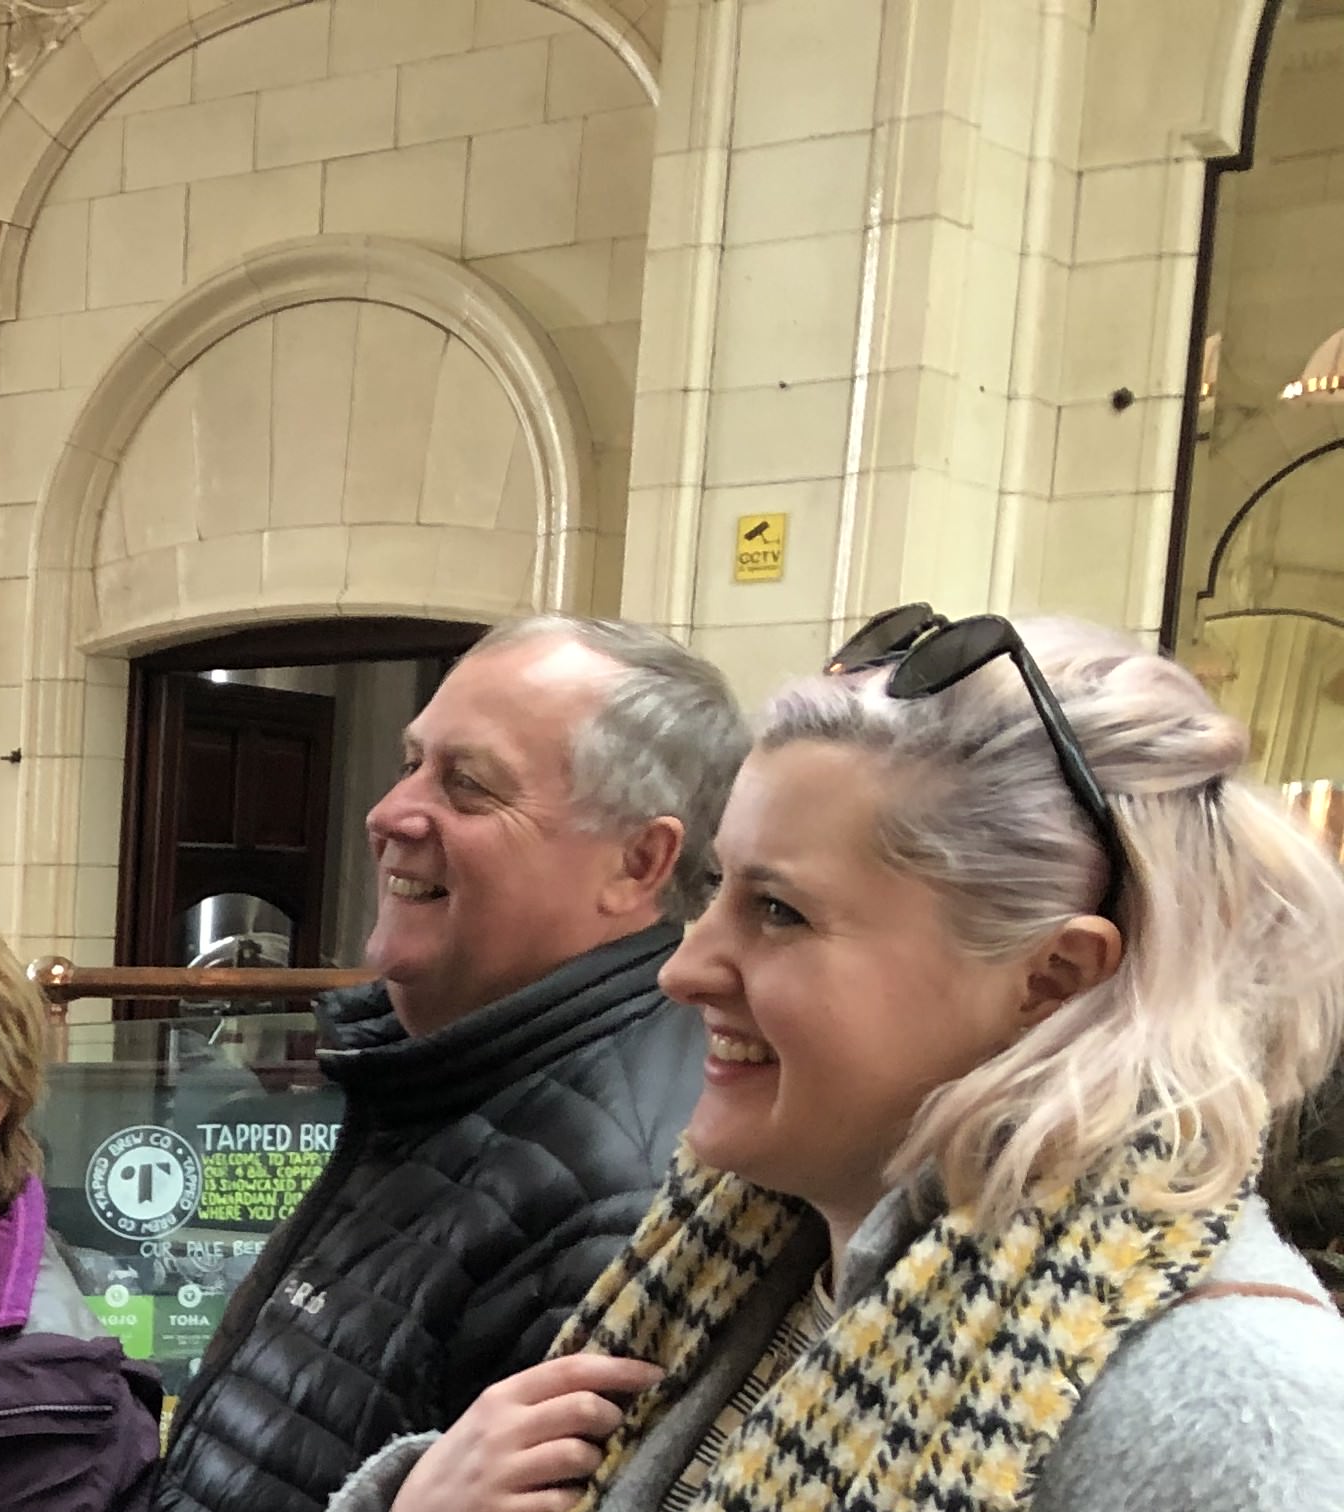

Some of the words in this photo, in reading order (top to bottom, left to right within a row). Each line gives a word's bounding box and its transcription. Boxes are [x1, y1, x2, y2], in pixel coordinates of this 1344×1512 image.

[739, 550, 781, 565] CCTV
[108, 1132, 144, 1156] BREW
[149, 1133, 172, 1149] CO
[196, 1124, 292, 1151] TAPPED
[201, 1152, 261, 1166] WELCOME
[267, 1152, 284, 1166] TO
[204, 1179, 216, 1191] IS
[219, 1179, 296, 1192] SHOWCASED
[202, 1192, 277, 1206] EDWARDIAN
[198, 1206, 242, 1220] WHERE
[248, 1206, 275, 1220] YOU
[140, 1241, 172, 1258] OUR
[169, 1314, 210, 1327] TOHA
